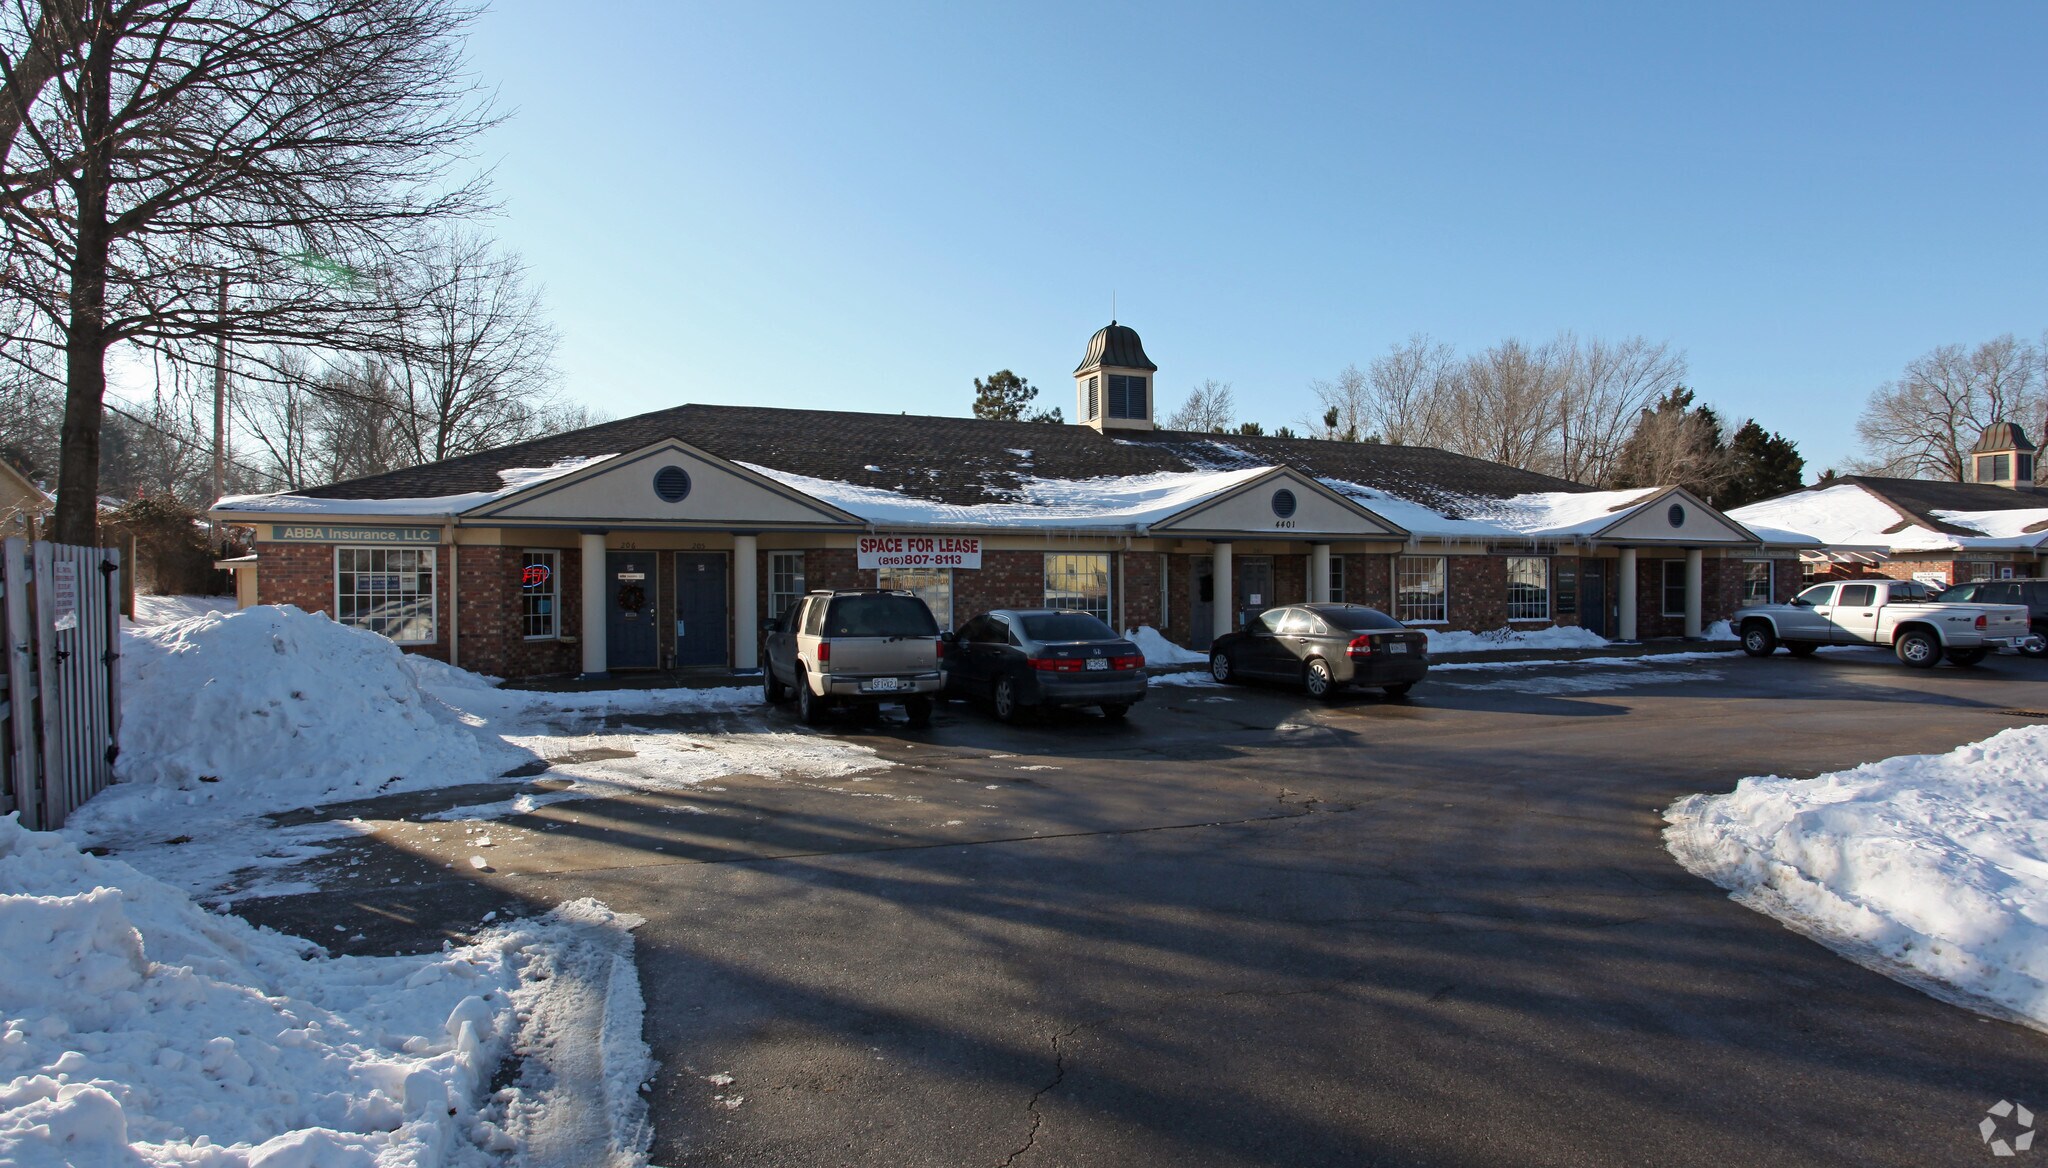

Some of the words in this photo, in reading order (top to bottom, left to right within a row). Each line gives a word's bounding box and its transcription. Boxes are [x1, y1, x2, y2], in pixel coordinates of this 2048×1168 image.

[1275, 520, 1295, 528] 4401
[283, 527, 324, 539] ABBA
[404, 529, 431, 541] LLC
[860, 538, 903, 553] SPACE
[907, 537, 934, 553] FOR
[938, 538, 979, 553] LEASE
[878, 554, 962, 565] (816)807-8113
[521, 567, 548, 583] PEN
